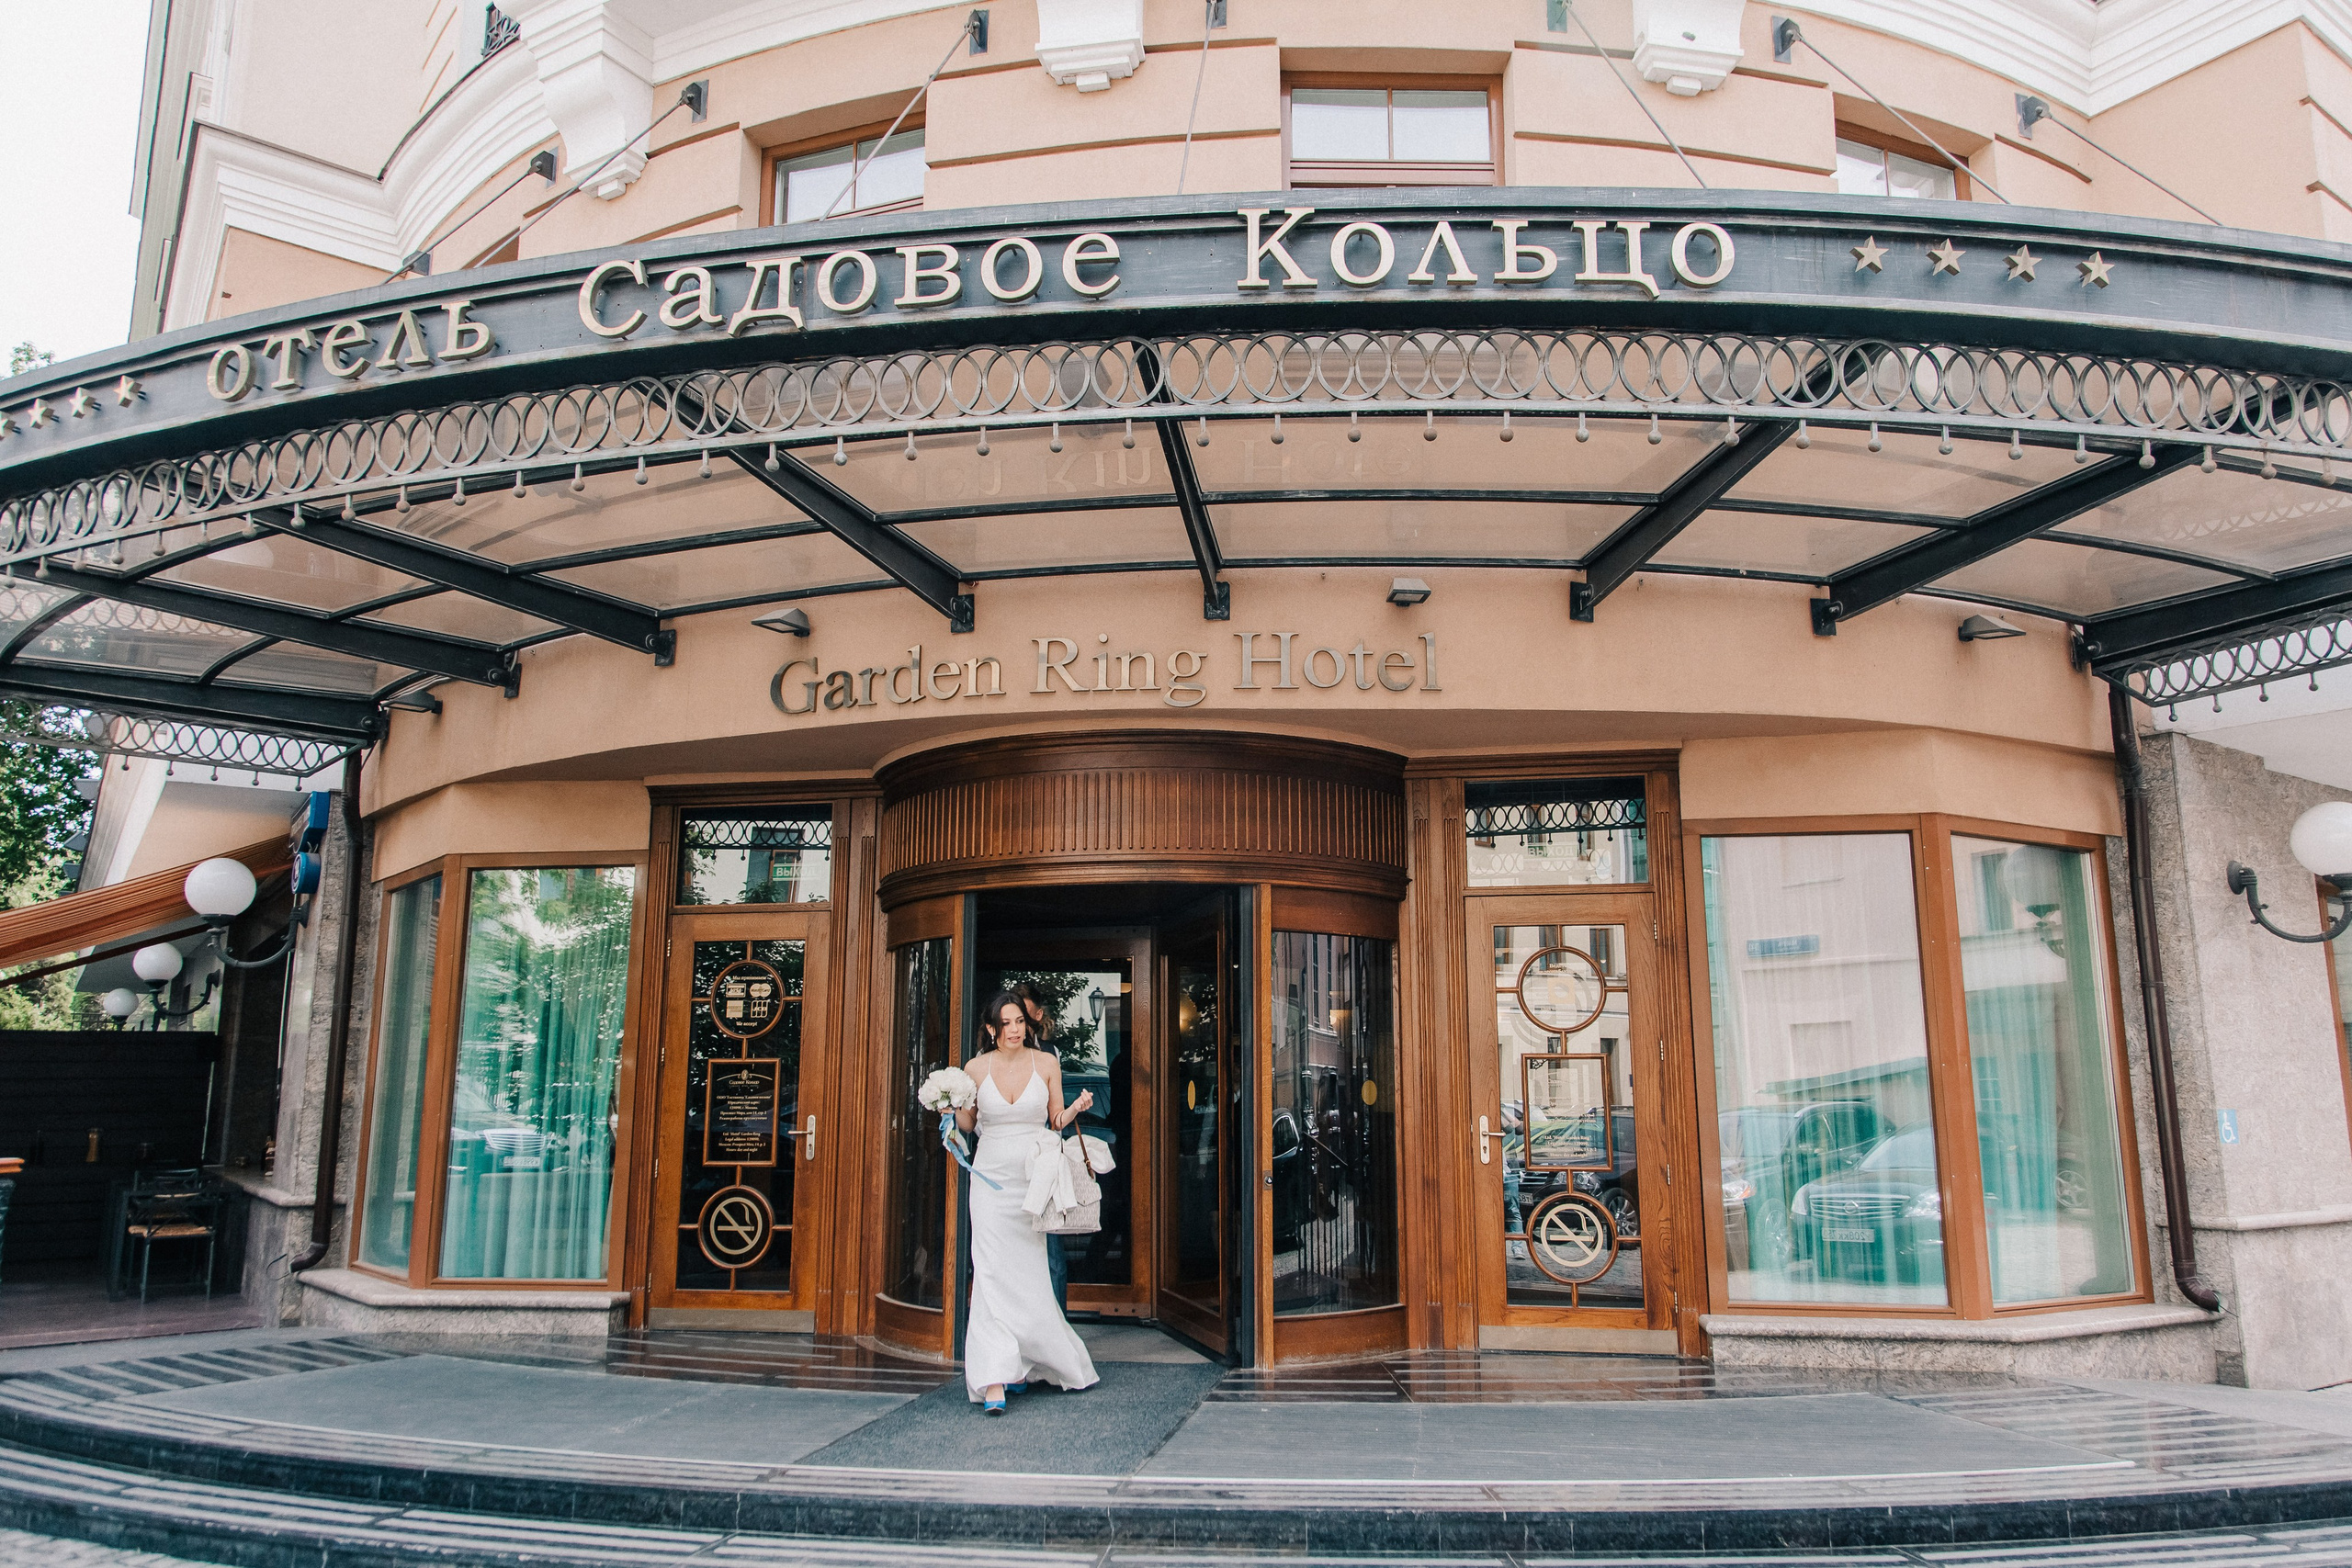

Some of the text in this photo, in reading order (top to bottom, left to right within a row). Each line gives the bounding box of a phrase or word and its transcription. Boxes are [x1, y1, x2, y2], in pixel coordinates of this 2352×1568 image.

[578, 232, 1121, 339] Садовое
[1237, 207, 1736, 300] Кольцо
[770, 632, 1442, 715] Garden Ring Hotel
[775, 866, 817, 877] ВЫХОД
[1528, 846, 1575, 857] ВЫХОД
